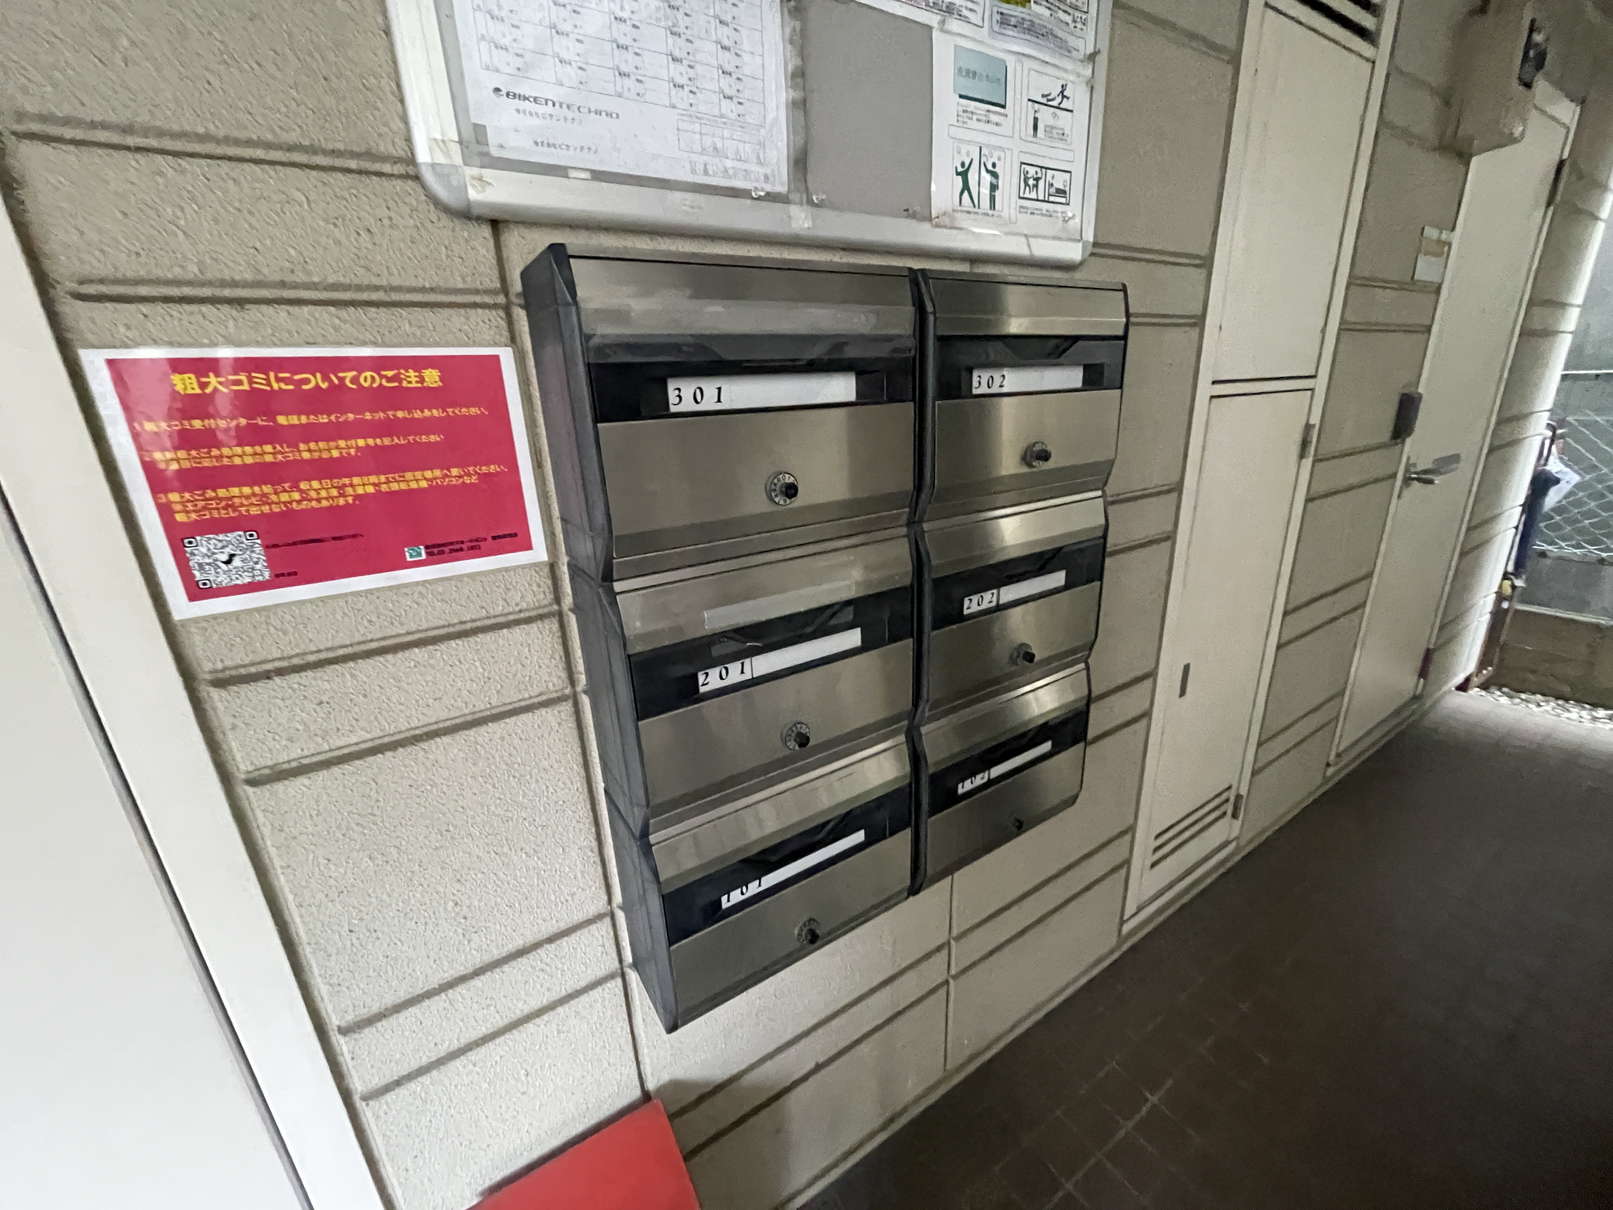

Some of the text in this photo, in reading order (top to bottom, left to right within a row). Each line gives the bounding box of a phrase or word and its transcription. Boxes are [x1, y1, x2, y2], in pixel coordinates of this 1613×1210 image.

[170, 368, 442, 395] 粗大ゴミについてのご注意
[974, 374, 1006, 389] 302
[671, 386, 722, 406] 301
[966, 592, 995, 610] 202
[700, 661, 745, 687] 201
